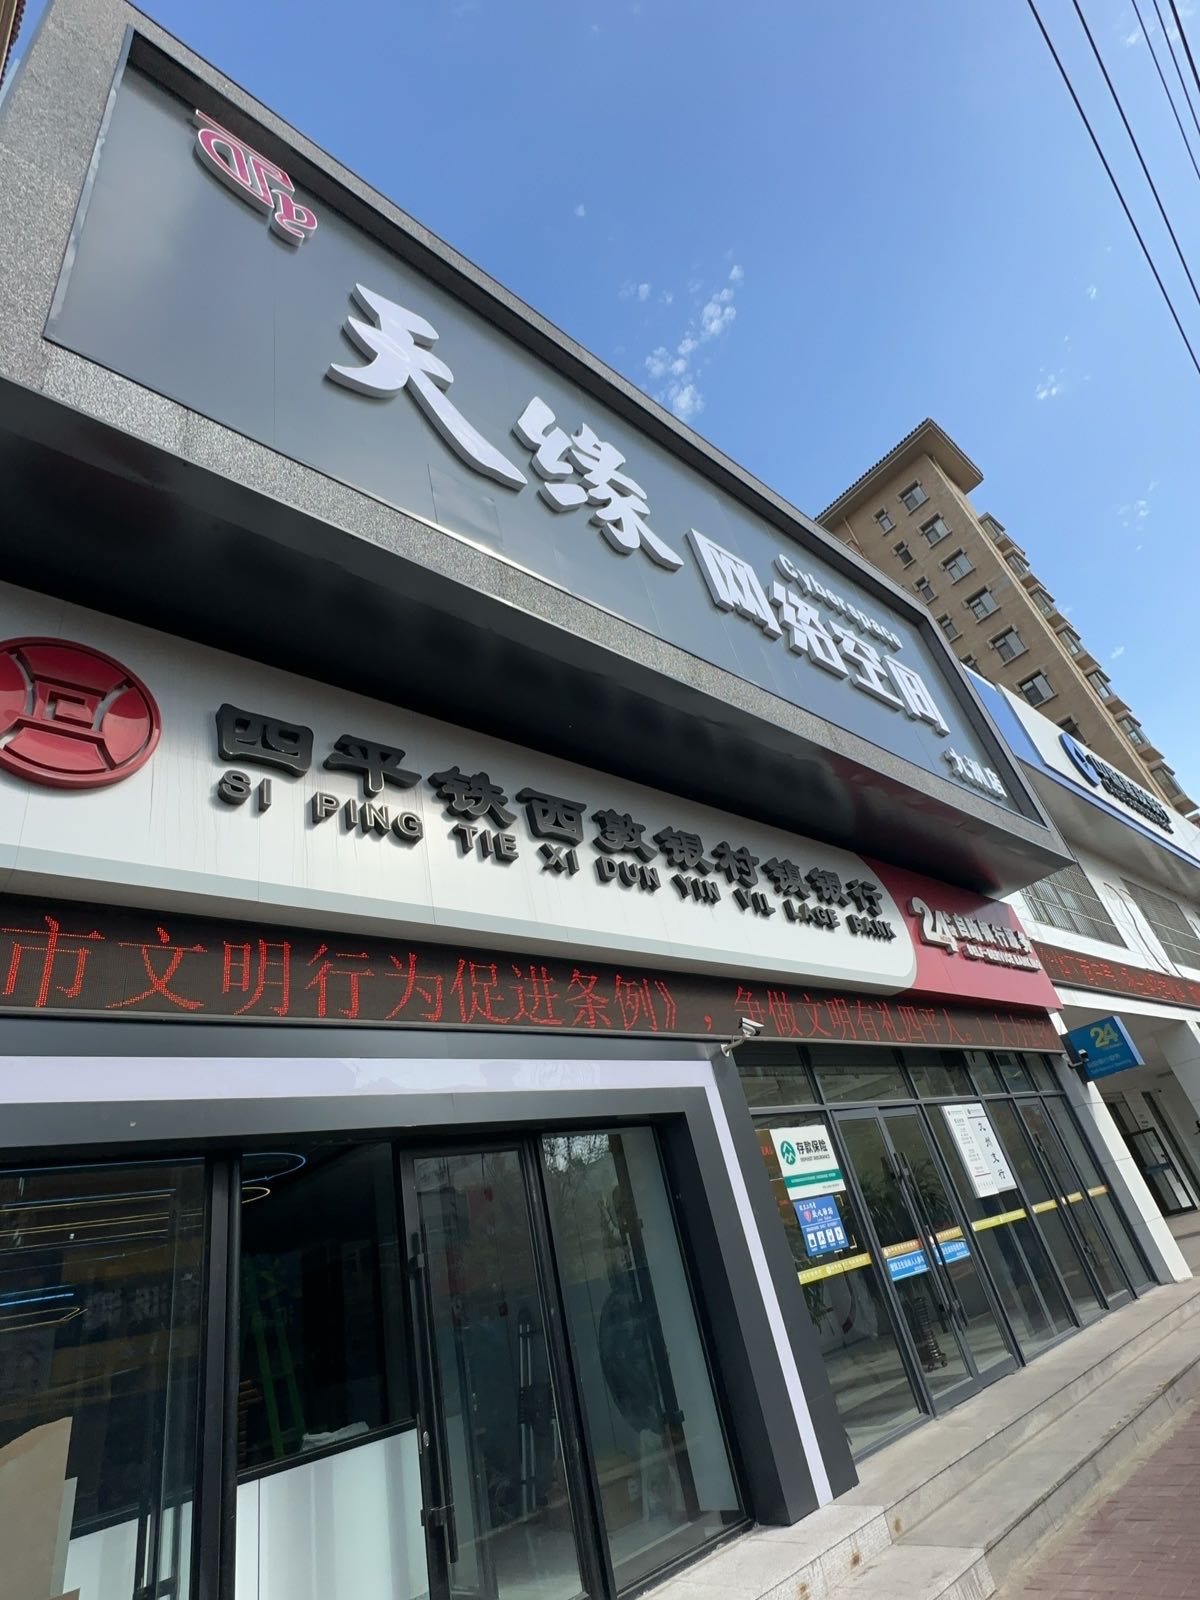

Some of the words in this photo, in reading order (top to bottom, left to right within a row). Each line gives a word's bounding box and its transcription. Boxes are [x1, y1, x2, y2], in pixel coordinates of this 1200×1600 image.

[686, 528, 950, 737] 网络空间
[775, 553, 903, 652] Cyberspace
[215, 703, 883, 917] 四平铁西敦银村镇银行
[217, 770, 273, 811] SI
[312, 792, 424, 845] PING
[453, 823, 520, 863] TIE
[537, 843, 581, 876] XI
[595, 856, 662, 893] DUN
[671, 873, 722, 905] YIN
[846, 914, 898, 942] BANK
[1090, 1023, 1118, 1048] 24
[795, 1139, 828, 1155] 存款保险
